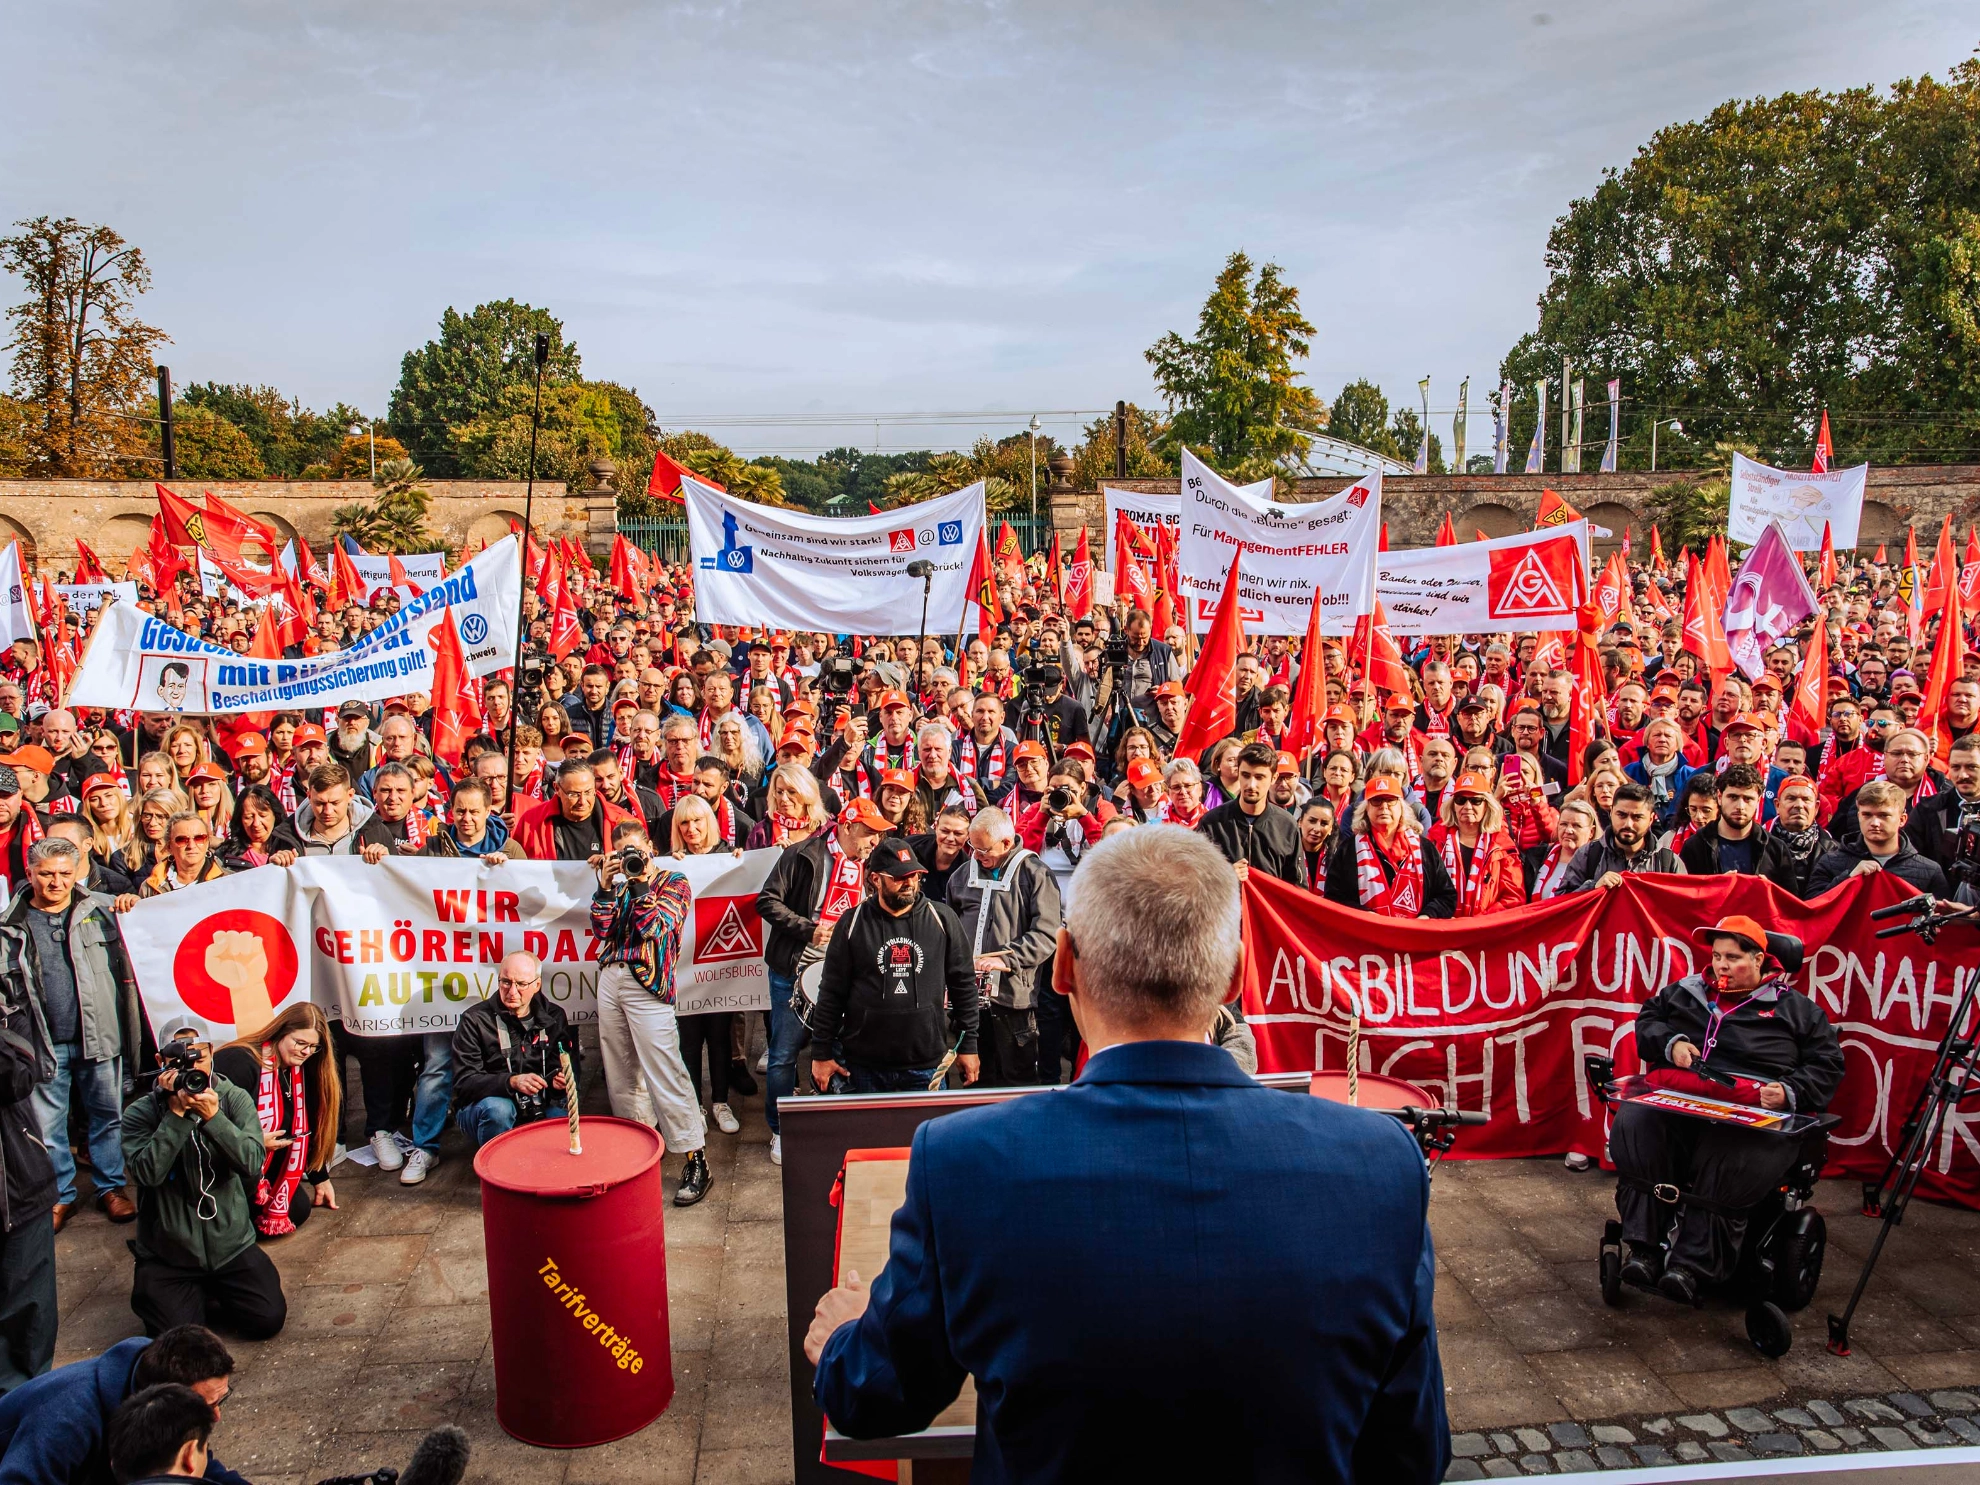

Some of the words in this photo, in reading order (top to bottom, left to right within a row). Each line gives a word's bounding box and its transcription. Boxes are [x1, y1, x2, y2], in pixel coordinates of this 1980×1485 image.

[1195, 490, 1229, 512] Durch
[1231, 507, 1248, 519] die
[1308, 510, 1352, 531] gesagt:
[806, 536, 828, 546] sind
[850, 536, 882, 546] stark!
[1192, 523, 1212, 537] Für
[1213, 529, 1349, 556] ManagementFEHLER
[815, 557, 853, 565] Zukunft
[854, 558, 889, 566] sichern
[891, 556, 906, 564] für
[1181, 575, 1221, 592] Macht
[1323, 593, 1350, 606] ob!!!
[1267, 577, 1287, 589] wir
[1289, 579, 1311, 590] nix.
[1379, 571, 1417, 585] Banker
[1421, 577, 1443, 587] oder
[1392, 603, 1438, 617] stärker!
[1425, 590, 1448, 601] sind
[1451, 595, 1470, 604] wir
[218, 663, 271, 686] mit
[397, 649, 428, 678] gilt!
[433, 889, 521, 924] WIR
[315, 918, 504, 965] GEHÖREN
[694, 964, 763, 984] WOLFSBURG
[1265, 942, 1578, 1023] AUSBILDUNG
[1592, 929, 1695, 994] UND
[538, 1257, 643, 1374] Tarifverträge
